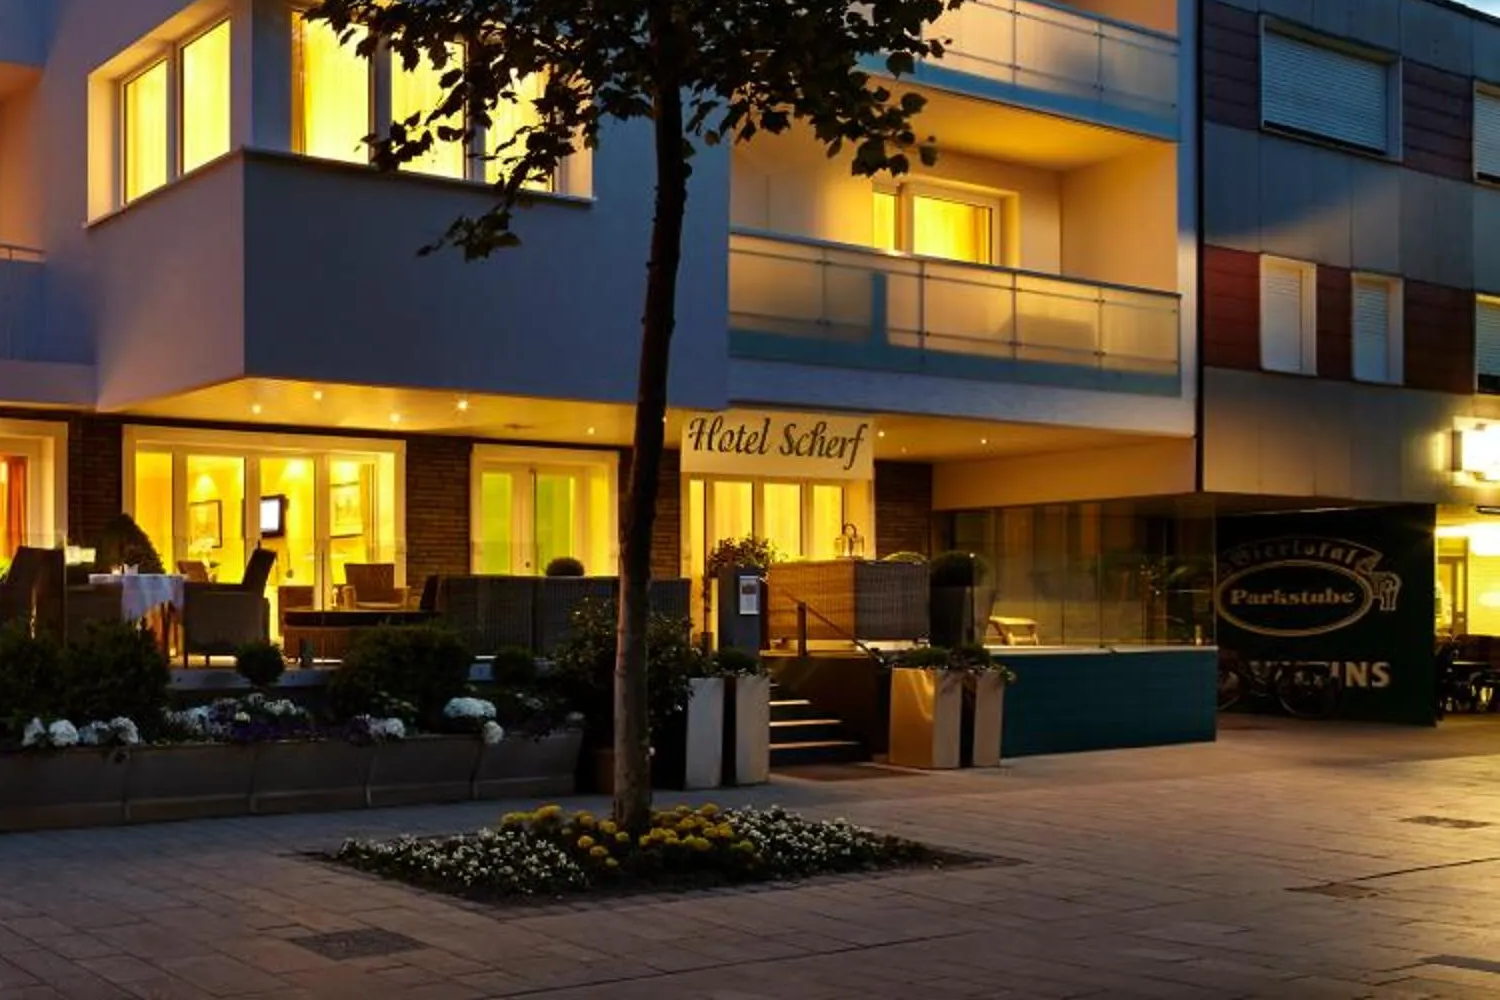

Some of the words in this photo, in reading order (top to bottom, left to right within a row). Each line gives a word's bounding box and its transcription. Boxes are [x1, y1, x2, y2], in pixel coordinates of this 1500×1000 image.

[688, 415, 769, 455] Hotel
[780, 421, 868, 471] Scherf
[1229, 587, 1356, 606] Parkstube
